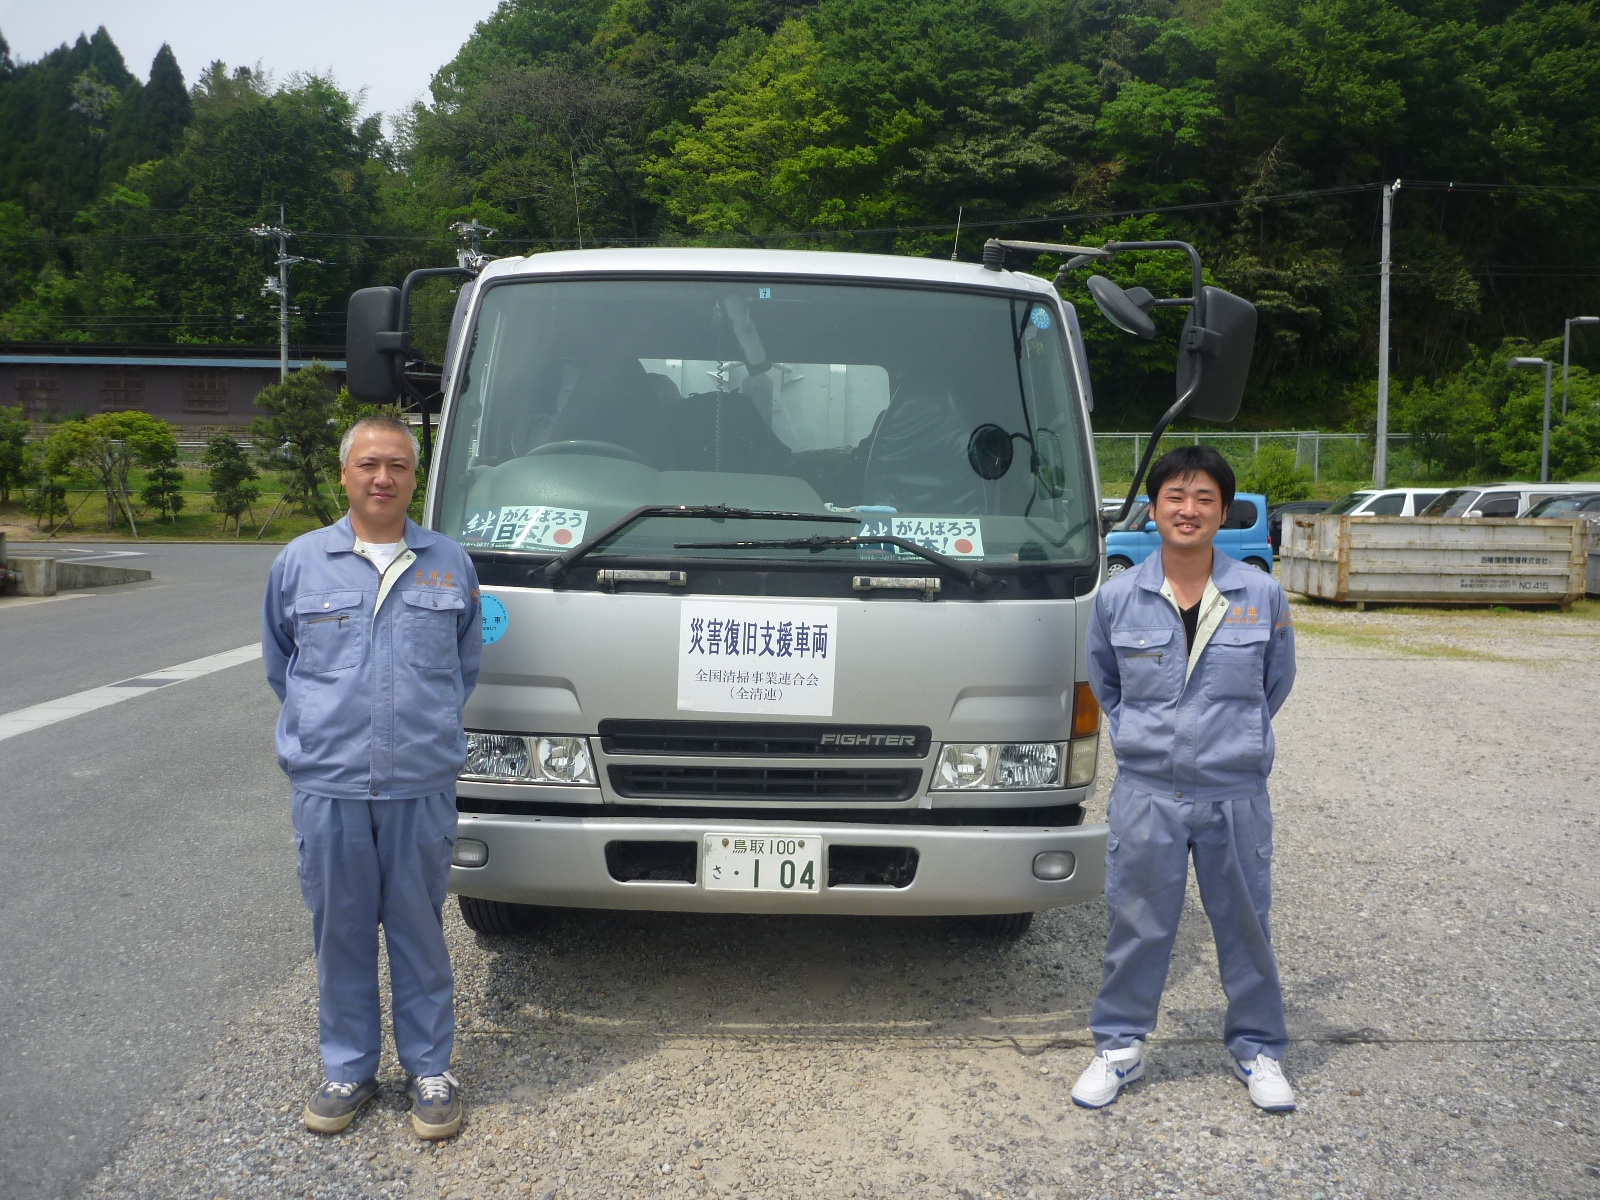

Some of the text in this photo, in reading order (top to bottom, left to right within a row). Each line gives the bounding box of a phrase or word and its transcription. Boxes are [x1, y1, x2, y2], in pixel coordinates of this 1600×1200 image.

[462, 510, 497, 538] 絆
[502, 508, 583, 528] がんばろう
[895, 521, 977, 537] がんばろう
[1519, 581, 1549, 590] NO.415
[688, 617, 829, 659] 災害復旧支援車両
[694, 668, 820, 687] 全国清掃事業連合会
[820, 733, 917, 747] FIGHTER
